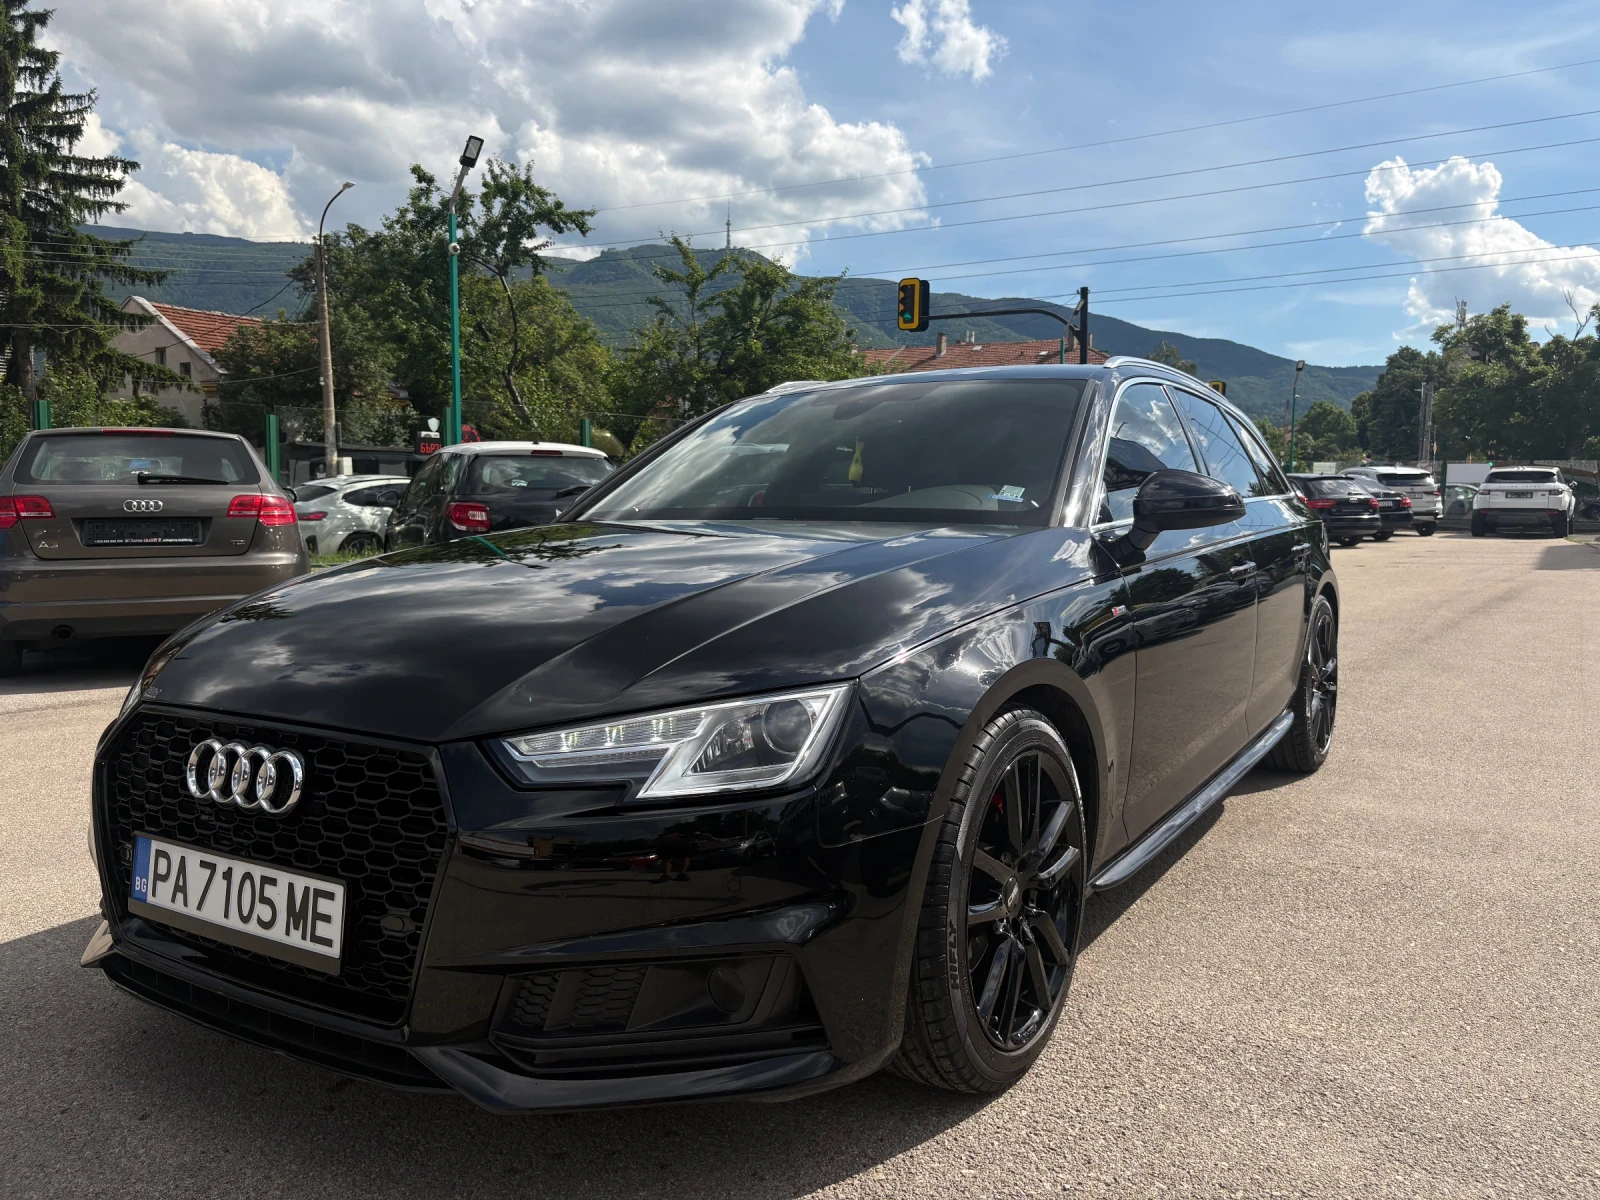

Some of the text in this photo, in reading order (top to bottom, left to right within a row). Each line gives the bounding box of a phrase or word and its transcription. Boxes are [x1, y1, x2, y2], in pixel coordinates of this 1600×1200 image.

[420, 442, 442, 454] БЪРЗ
[135, 876, 147, 893] BG
[948, 919, 960, 990] HIFLY
